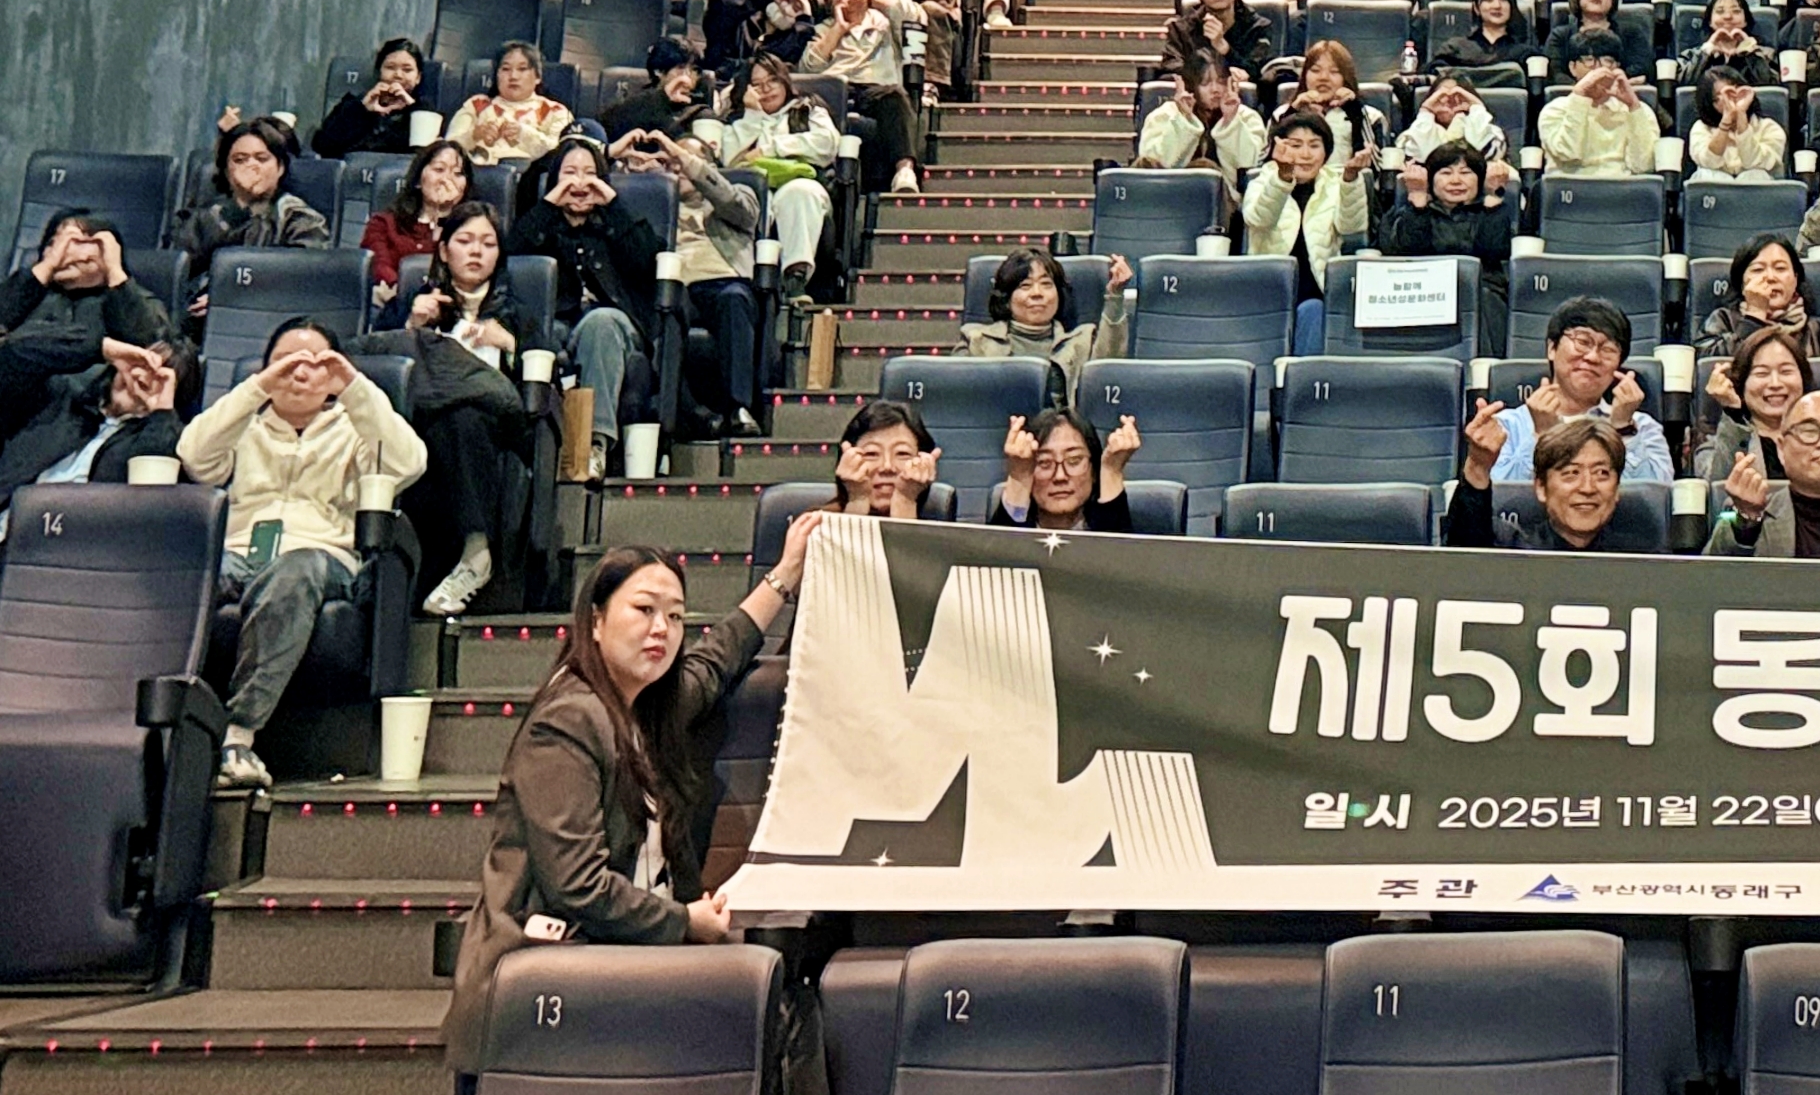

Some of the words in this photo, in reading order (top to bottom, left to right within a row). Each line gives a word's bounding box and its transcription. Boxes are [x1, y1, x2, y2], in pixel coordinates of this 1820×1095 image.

[1323, 11, 1334, 23] 12
[1445, 14, 1455, 25] 11
[347, 72, 359, 83] 17
[481, 75, 491, 87] 16
[51, 169, 66, 184] 17
[1114, 186, 1126, 200] 13
[1561, 190, 1573, 203] 10
[1703, 195, 1716, 209] 09
[236, 268, 252, 285] 15
[1163, 276, 1177, 292] 12
[1534, 275, 1548, 291] 10
[1713, 279, 1728, 295] 09
[907, 381, 923, 399] 13
[1105, 385, 1121, 403] 12
[1314, 381, 1329, 399] 11
[1517, 385, 1533, 401] 10
[42, 512, 64, 535] 14
[1256, 511, 1274, 532] 11
[1268, 595, 1658, 746] 제5회
[1438, 795, 1601, 829] 2025년
[1616, 795, 1697, 827] 11월
[944, 990, 970, 1020] 12
[1373, 985, 1399, 1016] 11
[535, 995, 562, 1026] 13
